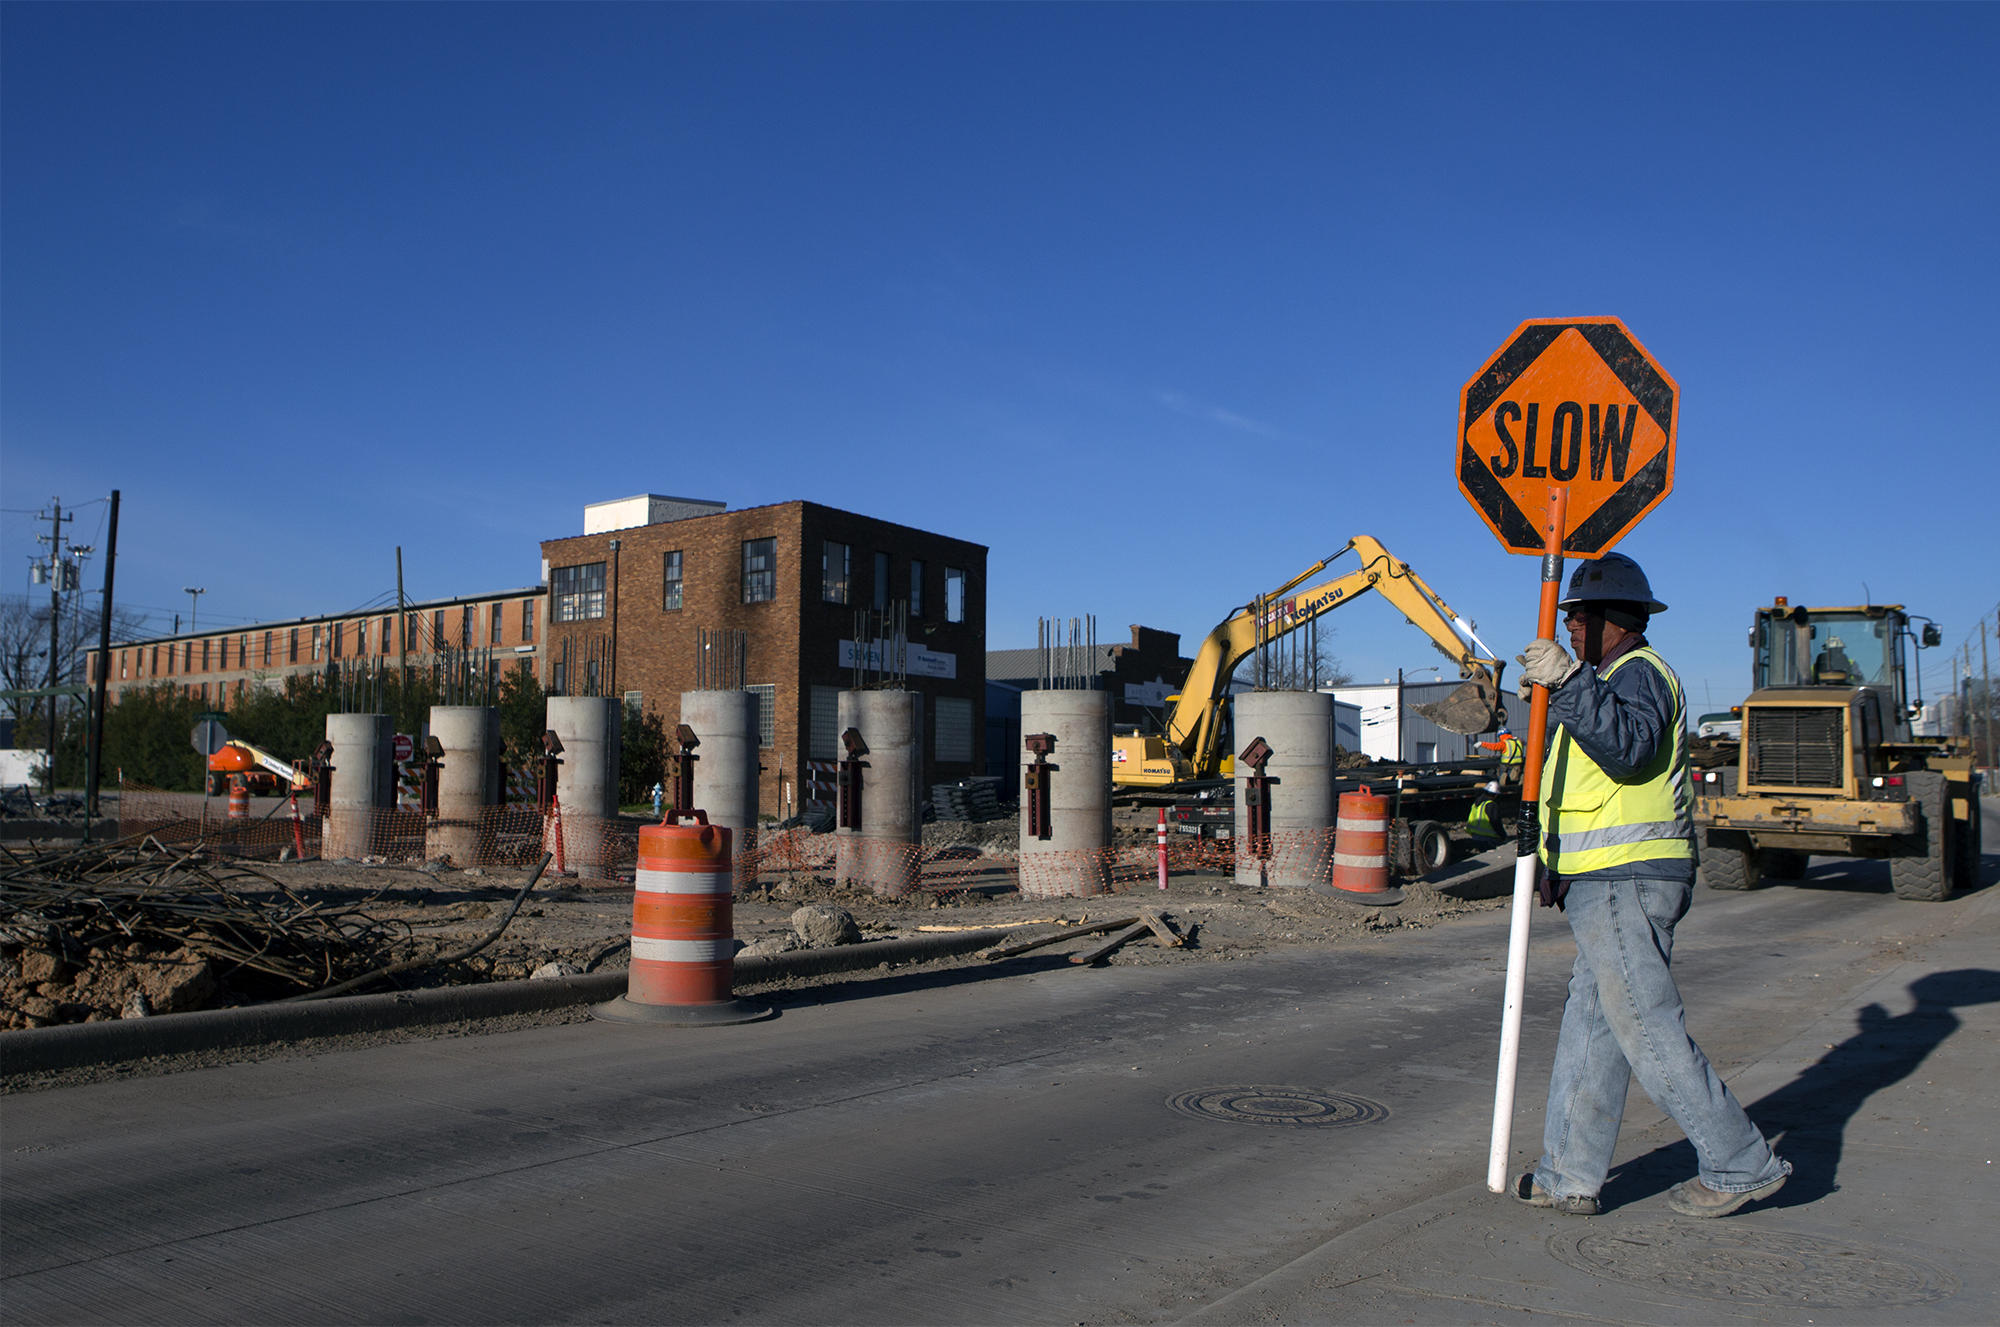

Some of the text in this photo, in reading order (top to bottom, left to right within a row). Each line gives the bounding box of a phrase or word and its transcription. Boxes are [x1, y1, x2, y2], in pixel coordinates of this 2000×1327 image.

[1490, 400, 1639, 482] SLOW
[1290, 587, 1344, 620] KOMATSU
[1143, 767, 1171, 775] KOMATSU
